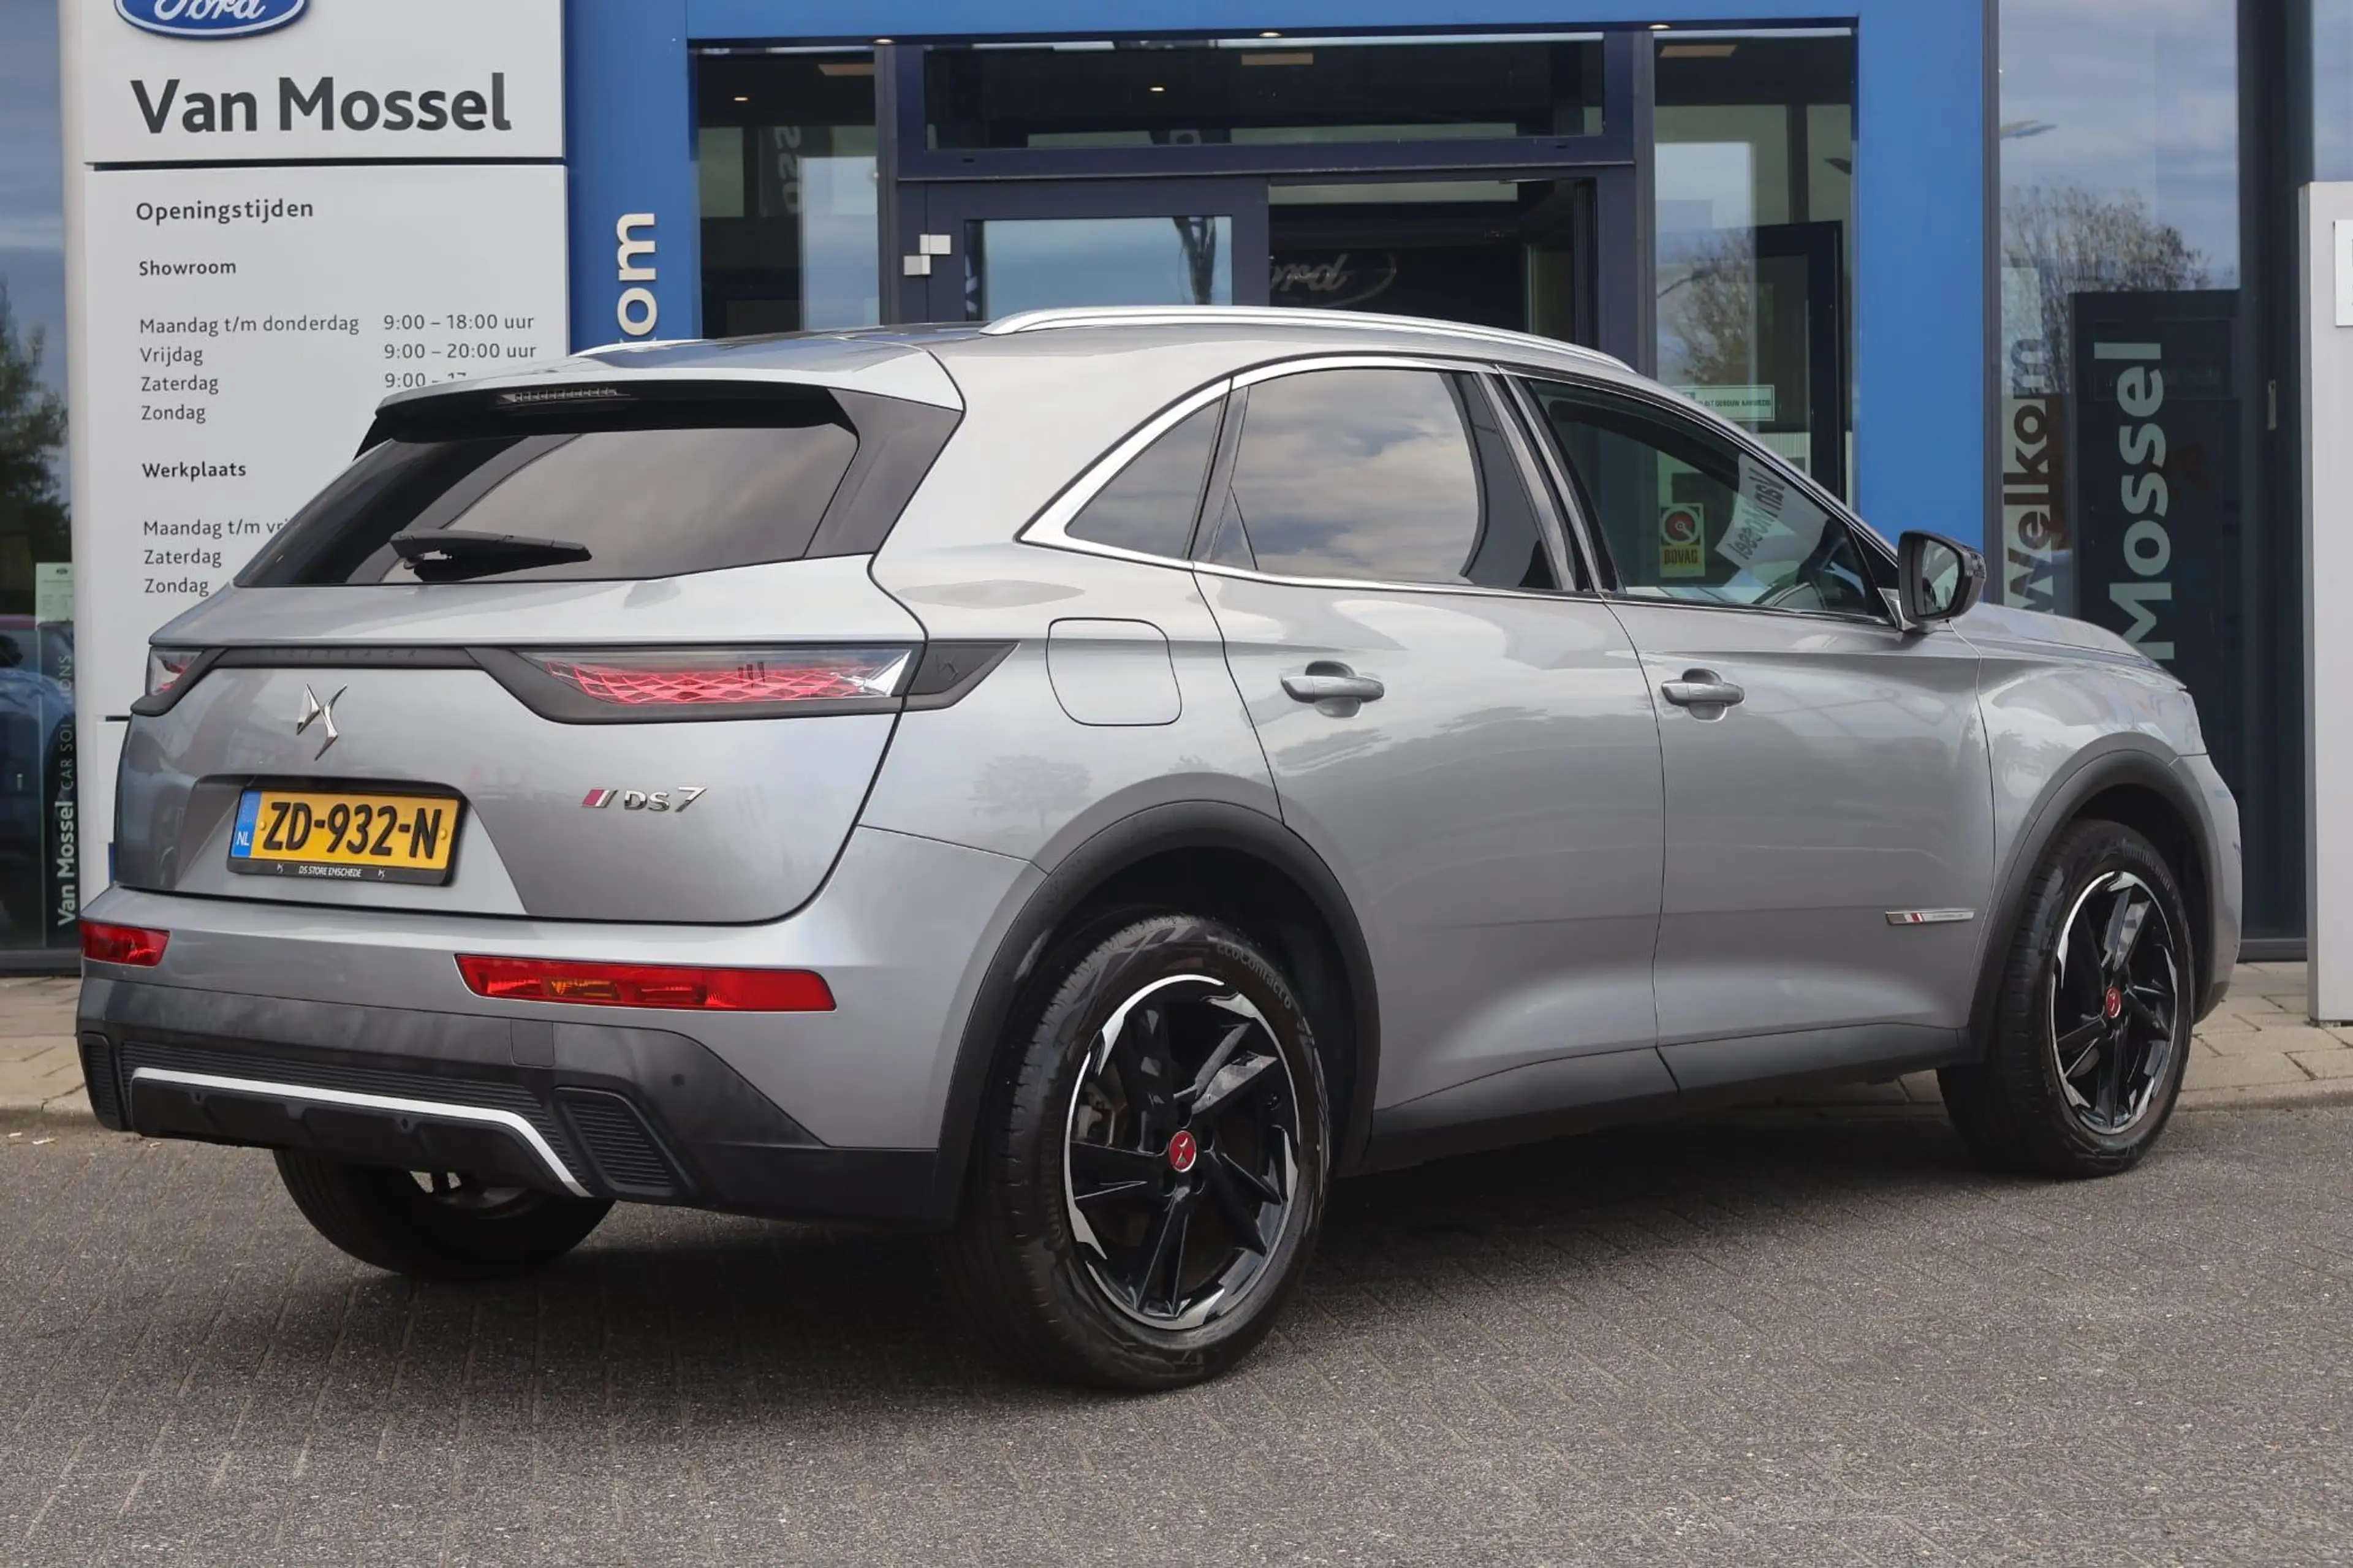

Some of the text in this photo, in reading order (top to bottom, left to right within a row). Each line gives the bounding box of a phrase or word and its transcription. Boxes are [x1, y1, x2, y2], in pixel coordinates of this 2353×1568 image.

[129, 72, 512, 134] Van Mossel
[136, 198, 313, 226] Openingstijden
[139, 259, 237, 276] Showroom
[140, 316, 219, 338] Maandag
[224, 316, 257, 332] t/m
[262, 314, 360, 335] donderdag
[384, 314, 425, 330] 9:00
[447, 314, 498, 330] 18:00
[504, 317, 534, 329] uur
[140, 346, 203, 368] Vrijdag
[384, 343, 425, 359] 9:00
[447, 343, 500, 358] 20:00
[507, 346, 537, 358] uur
[141, 374, 219, 395] Zaterdag
[385, 372, 426, 388] 9:00
[142, 404, 206, 425] Zondag
[142, 461, 246, 482] Werkplaats
[2094, 343, 2175, 660] Mossel
[143, 519, 222, 540] Maandag
[227, 518, 260, 535] t/m
[144, 547, 222, 569] Zaterdag
[145, 577, 209, 597] Zondag
[61, 759, 74, 790] CAR
[623, 786, 708, 812] DS 7
[55, 801, 75, 877] Mossel
[237, 833, 250, 846] NL
[263, 801, 442, 859] ZD-932-N
[308, 866, 327, 876] STORE
[328, 868, 362, 877] ENSCHEDE
[58, 884, 76, 926] Van
